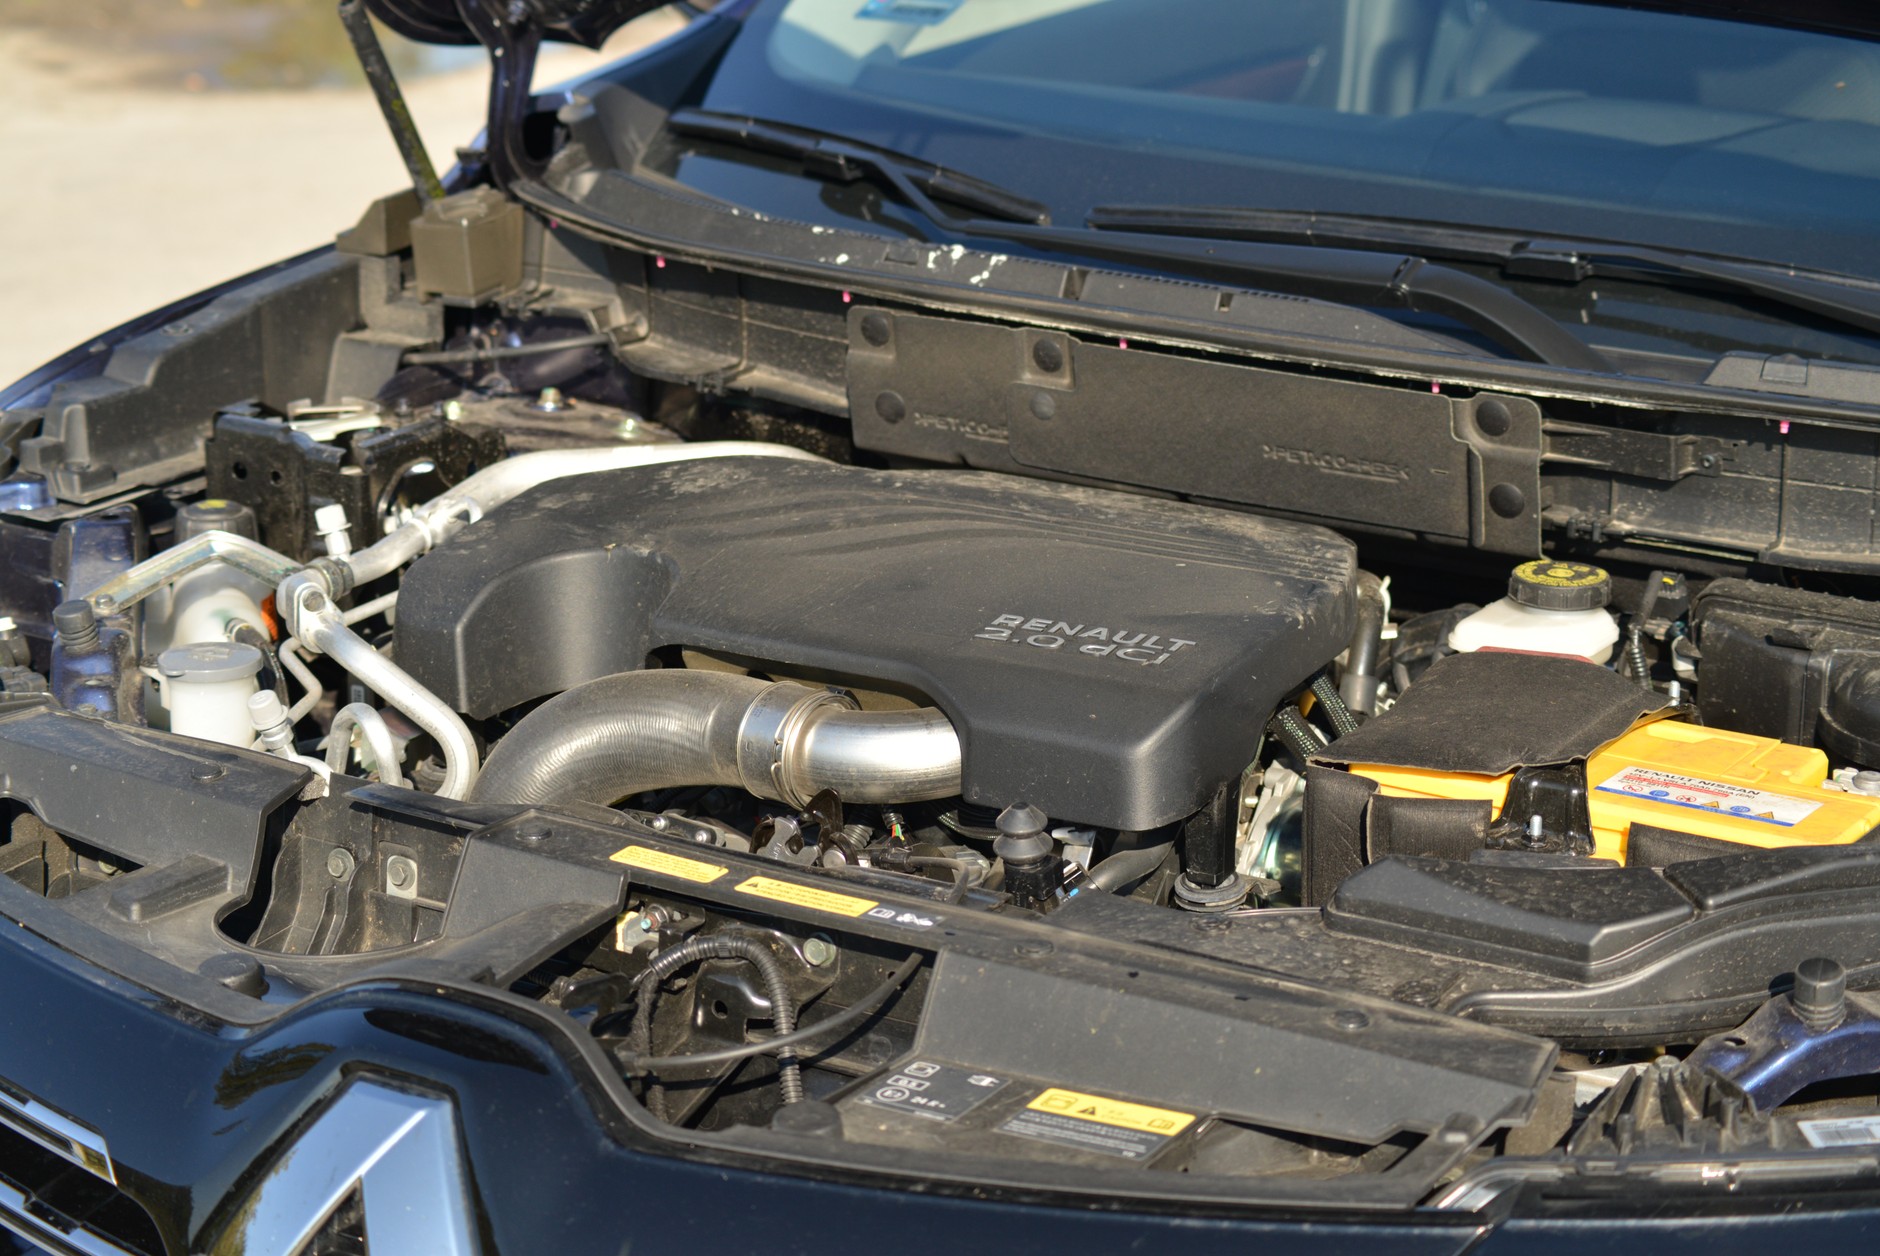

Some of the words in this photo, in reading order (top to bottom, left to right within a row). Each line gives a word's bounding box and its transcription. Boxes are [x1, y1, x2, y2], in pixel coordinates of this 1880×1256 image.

[973, 626, 1066, 649] 2.0
[990, 613, 1198, 652] RENAULT
[1634, 768, 1697, 782] RENAULT
[1698, 780, 1761, 796] NISSAN
